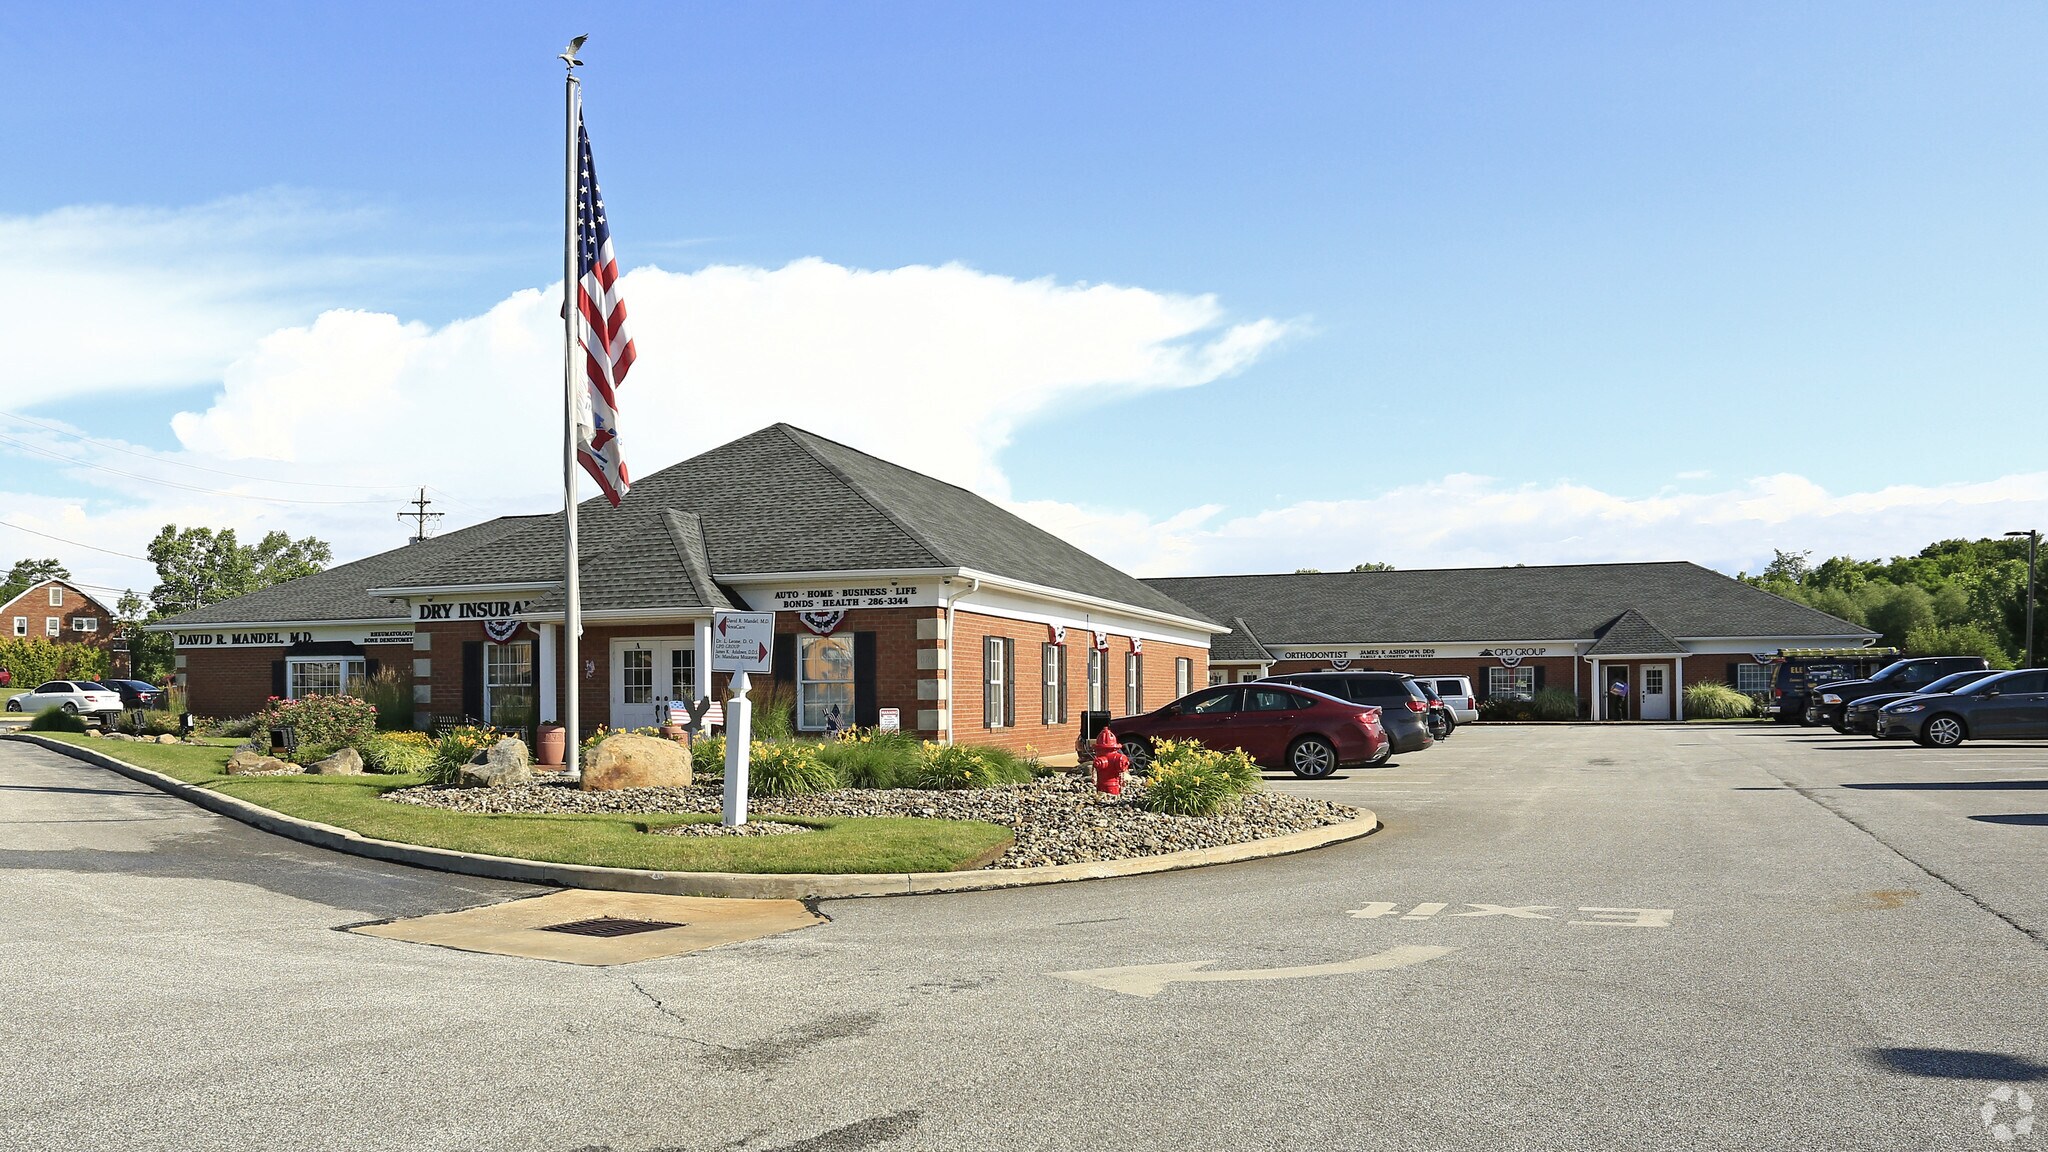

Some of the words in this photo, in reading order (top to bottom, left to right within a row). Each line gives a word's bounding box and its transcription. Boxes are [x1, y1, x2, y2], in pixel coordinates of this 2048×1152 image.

[775, 591, 799, 599] AUTO
[807, 590, 833, 598] HOME
[842, 588, 887, 597] BUSINESS
[895, 587, 917, 595] LIFE
[783, 600, 814, 608] BONDS
[822, 599, 859, 607] HEALTH
[867, 597, 908, 605] 286-3344
[419, 604, 453, 620] DRY
[459, 600, 530, 618] INSURA
[178, 634, 213, 645] DAVID
[216, 634, 227, 645] R.
[289, 632, 314, 643] M.D.
[1285, 651, 1348, 659] ORTHODONTIST
[1515, 648, 1546, 656] GROUP
